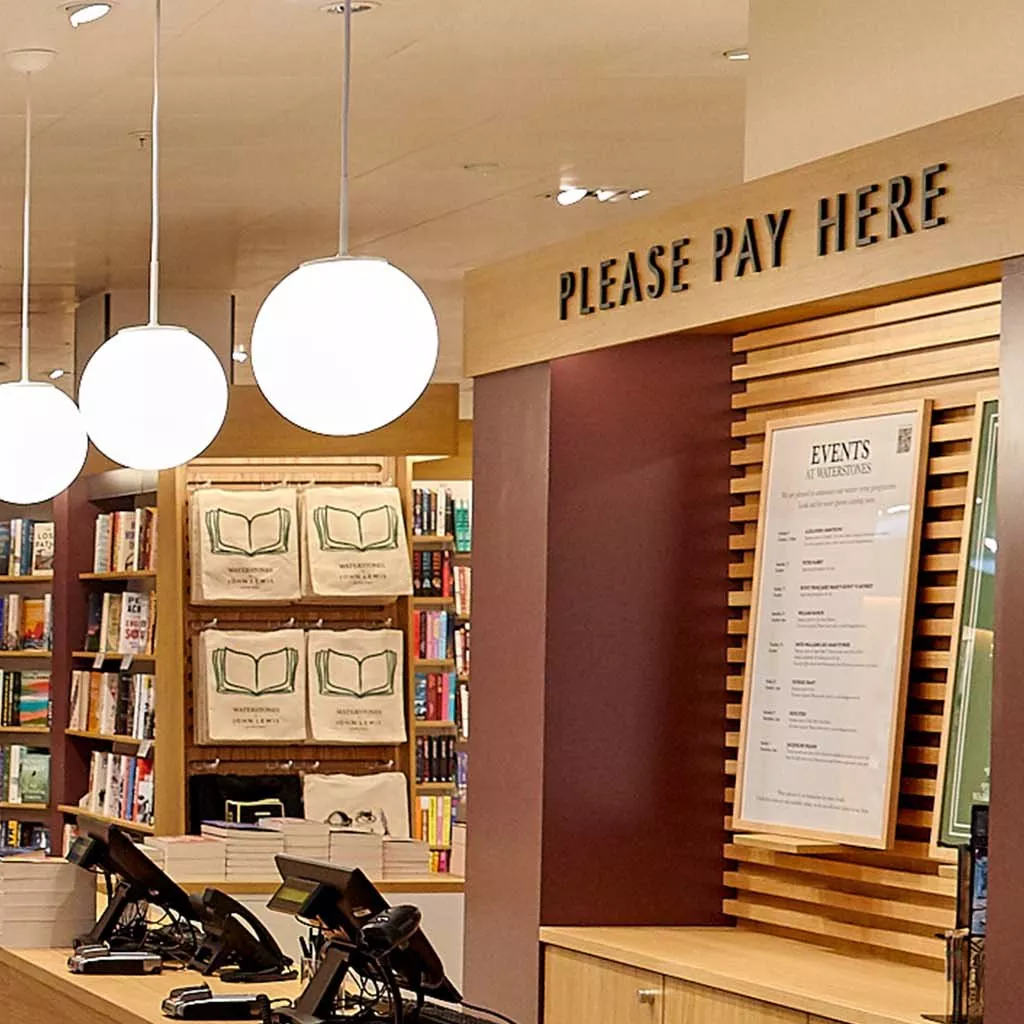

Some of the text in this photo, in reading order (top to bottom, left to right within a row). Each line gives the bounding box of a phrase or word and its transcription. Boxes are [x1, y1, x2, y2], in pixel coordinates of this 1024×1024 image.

[559, 162, 948, 320] PLEASE PAY HERE
[811, 439, 871, 465] EVENTS
[805, 462, 872, 480] AT WATERSTONES
